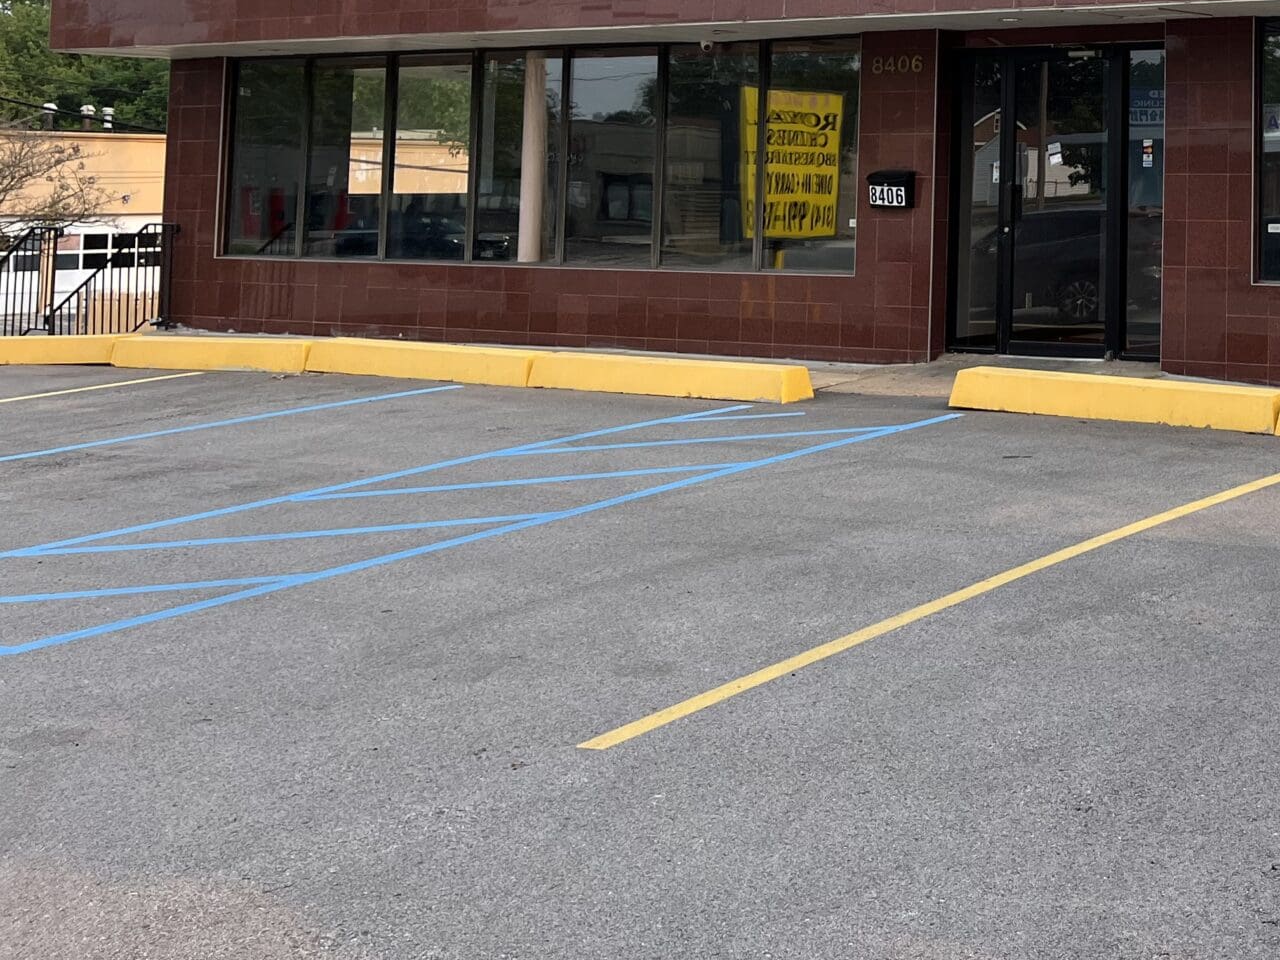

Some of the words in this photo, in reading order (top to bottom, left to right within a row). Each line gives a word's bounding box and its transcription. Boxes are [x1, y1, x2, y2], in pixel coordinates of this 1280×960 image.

[872, 55, 923, 74] 8406
[1267, 114, 1279, 130] A
[870, 186, 904, 205] 8406
